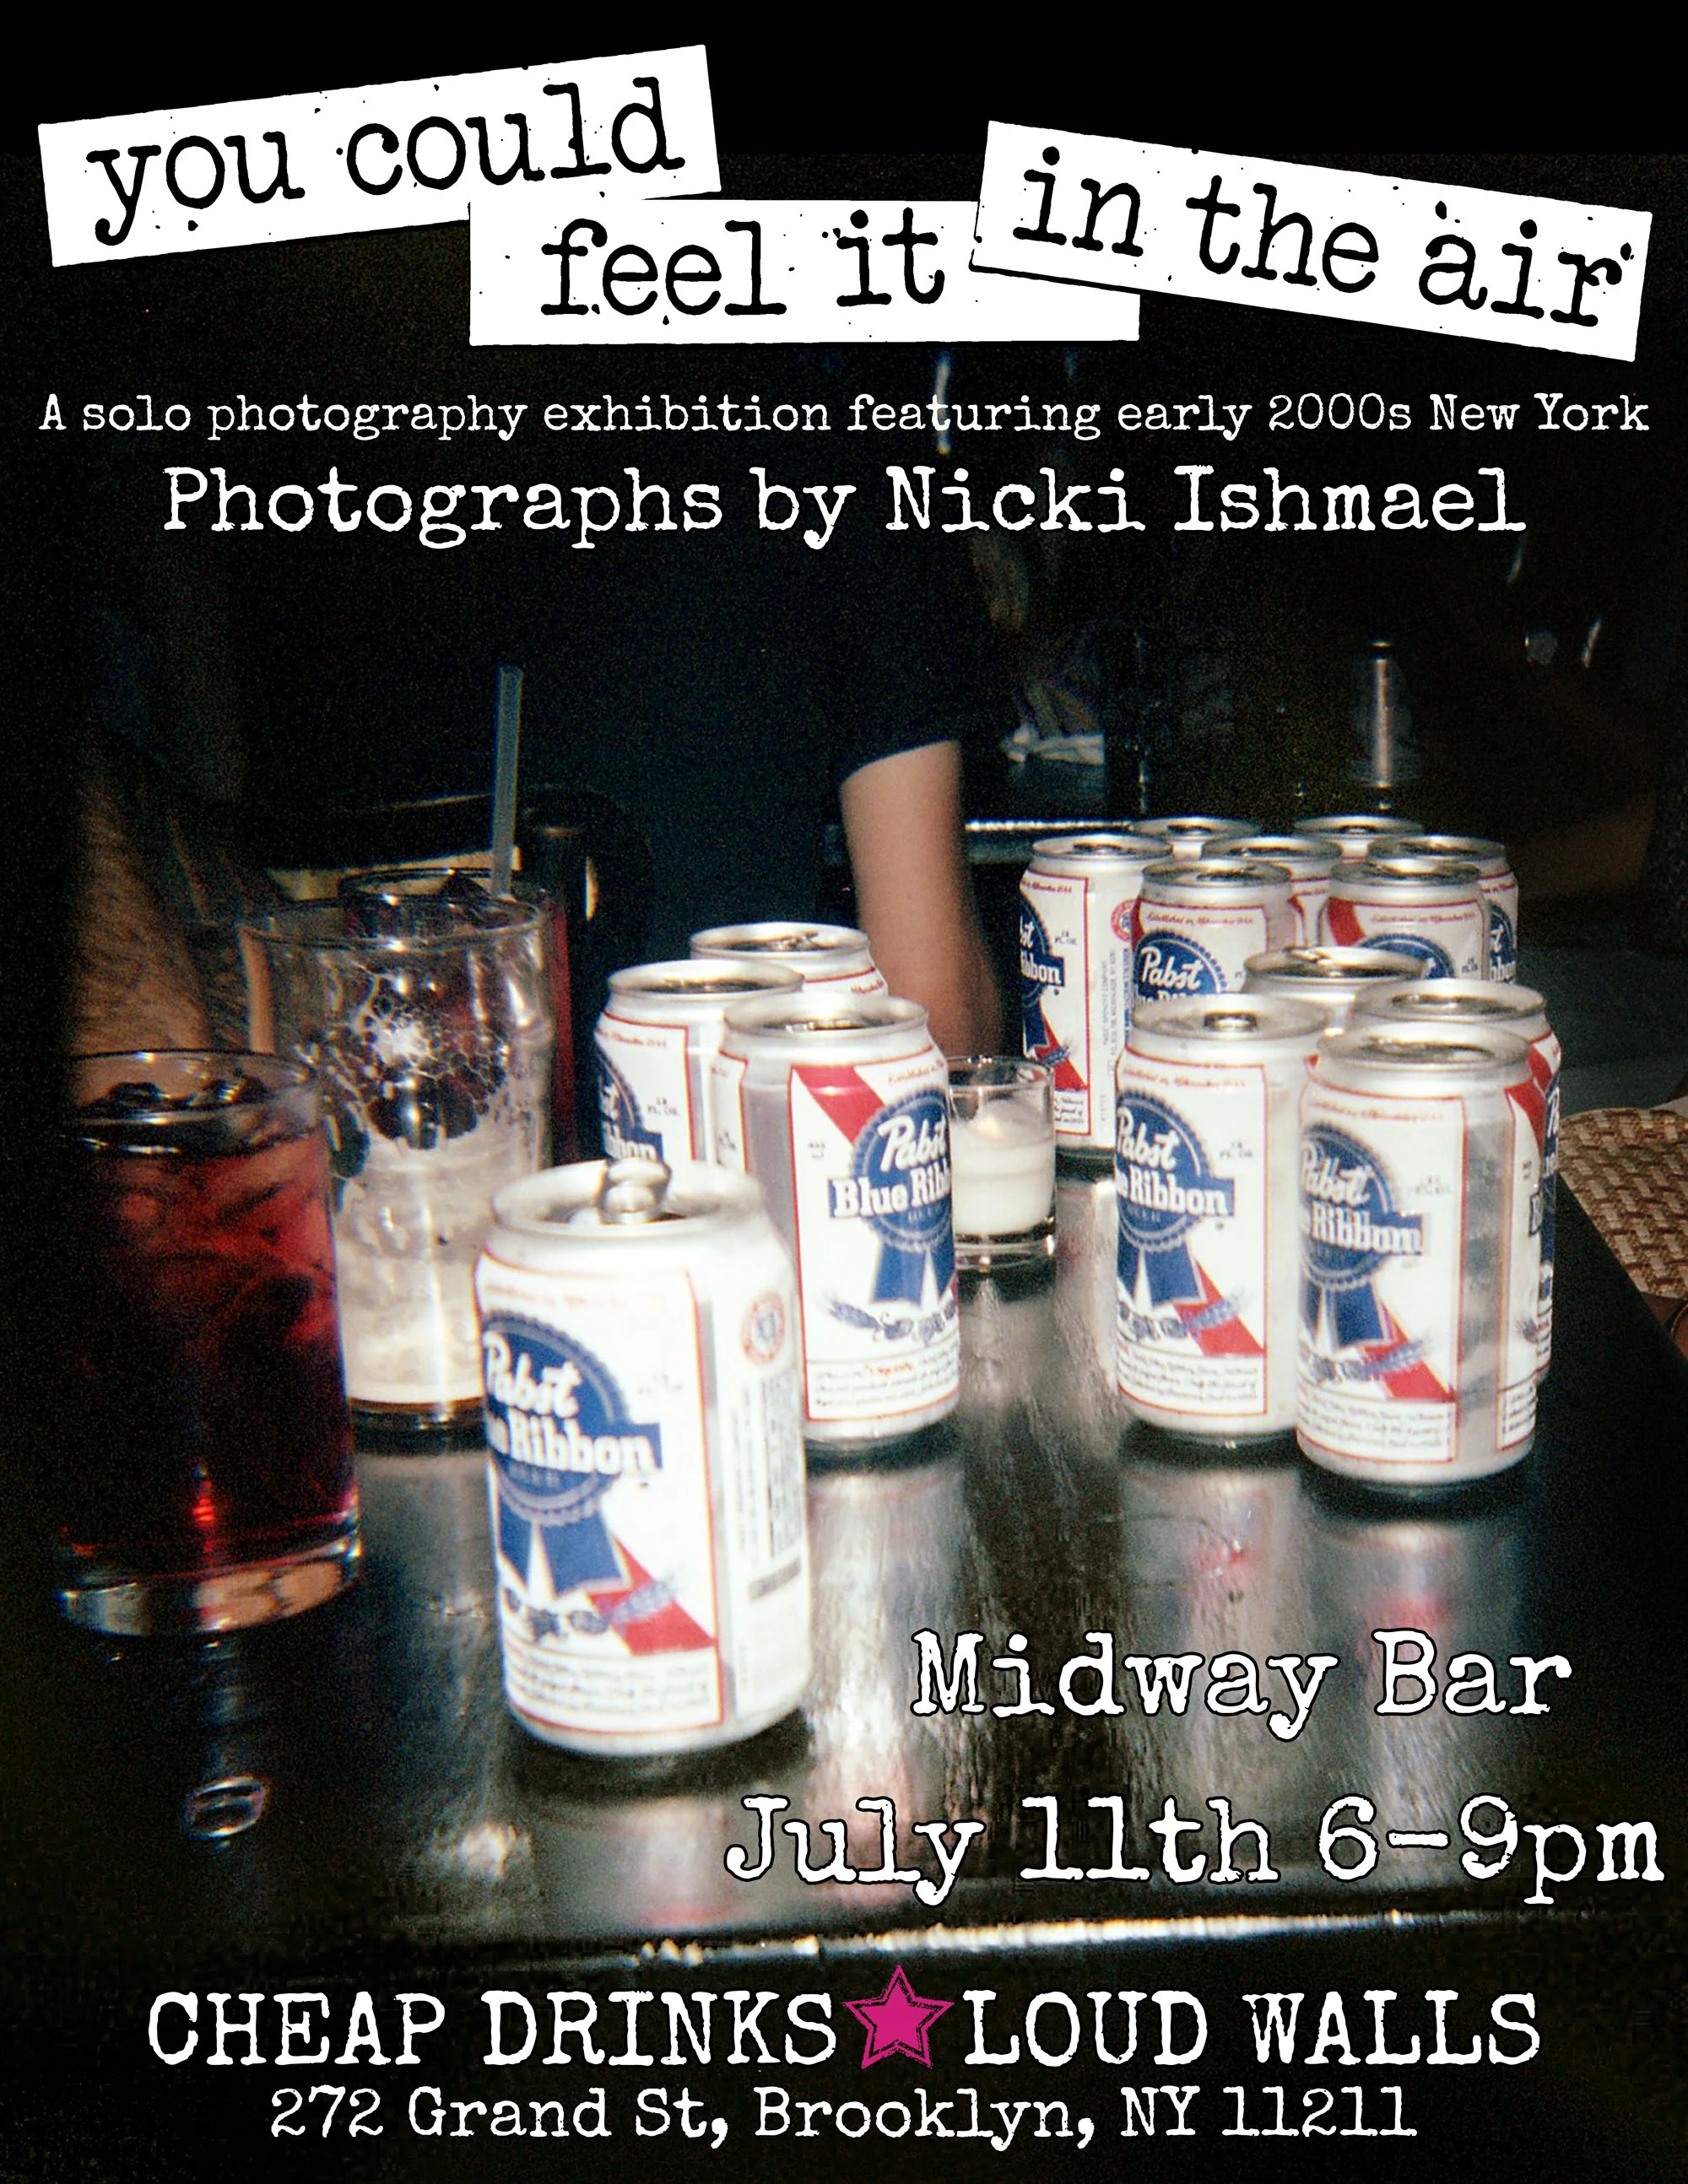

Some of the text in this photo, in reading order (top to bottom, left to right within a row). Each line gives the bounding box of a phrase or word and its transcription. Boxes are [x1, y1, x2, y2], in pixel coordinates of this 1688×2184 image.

[1140, 946, 1204, 991] Pabst
[878, 1113, 947, 1172] Pabst
[1116, 1106, 1180, 1170] Pabst
[830, 1176, 909, 1218] Blue
[1128, 1164, 1229, 1216] Ribbon
[1302, 1141, 1376, 1208] Pabst
[1310, 1197, 1421, 1255] Ribbon
[483, 1331, 582, 1419] Pabst
[508, 1407, 660, 1476] Ribbon
